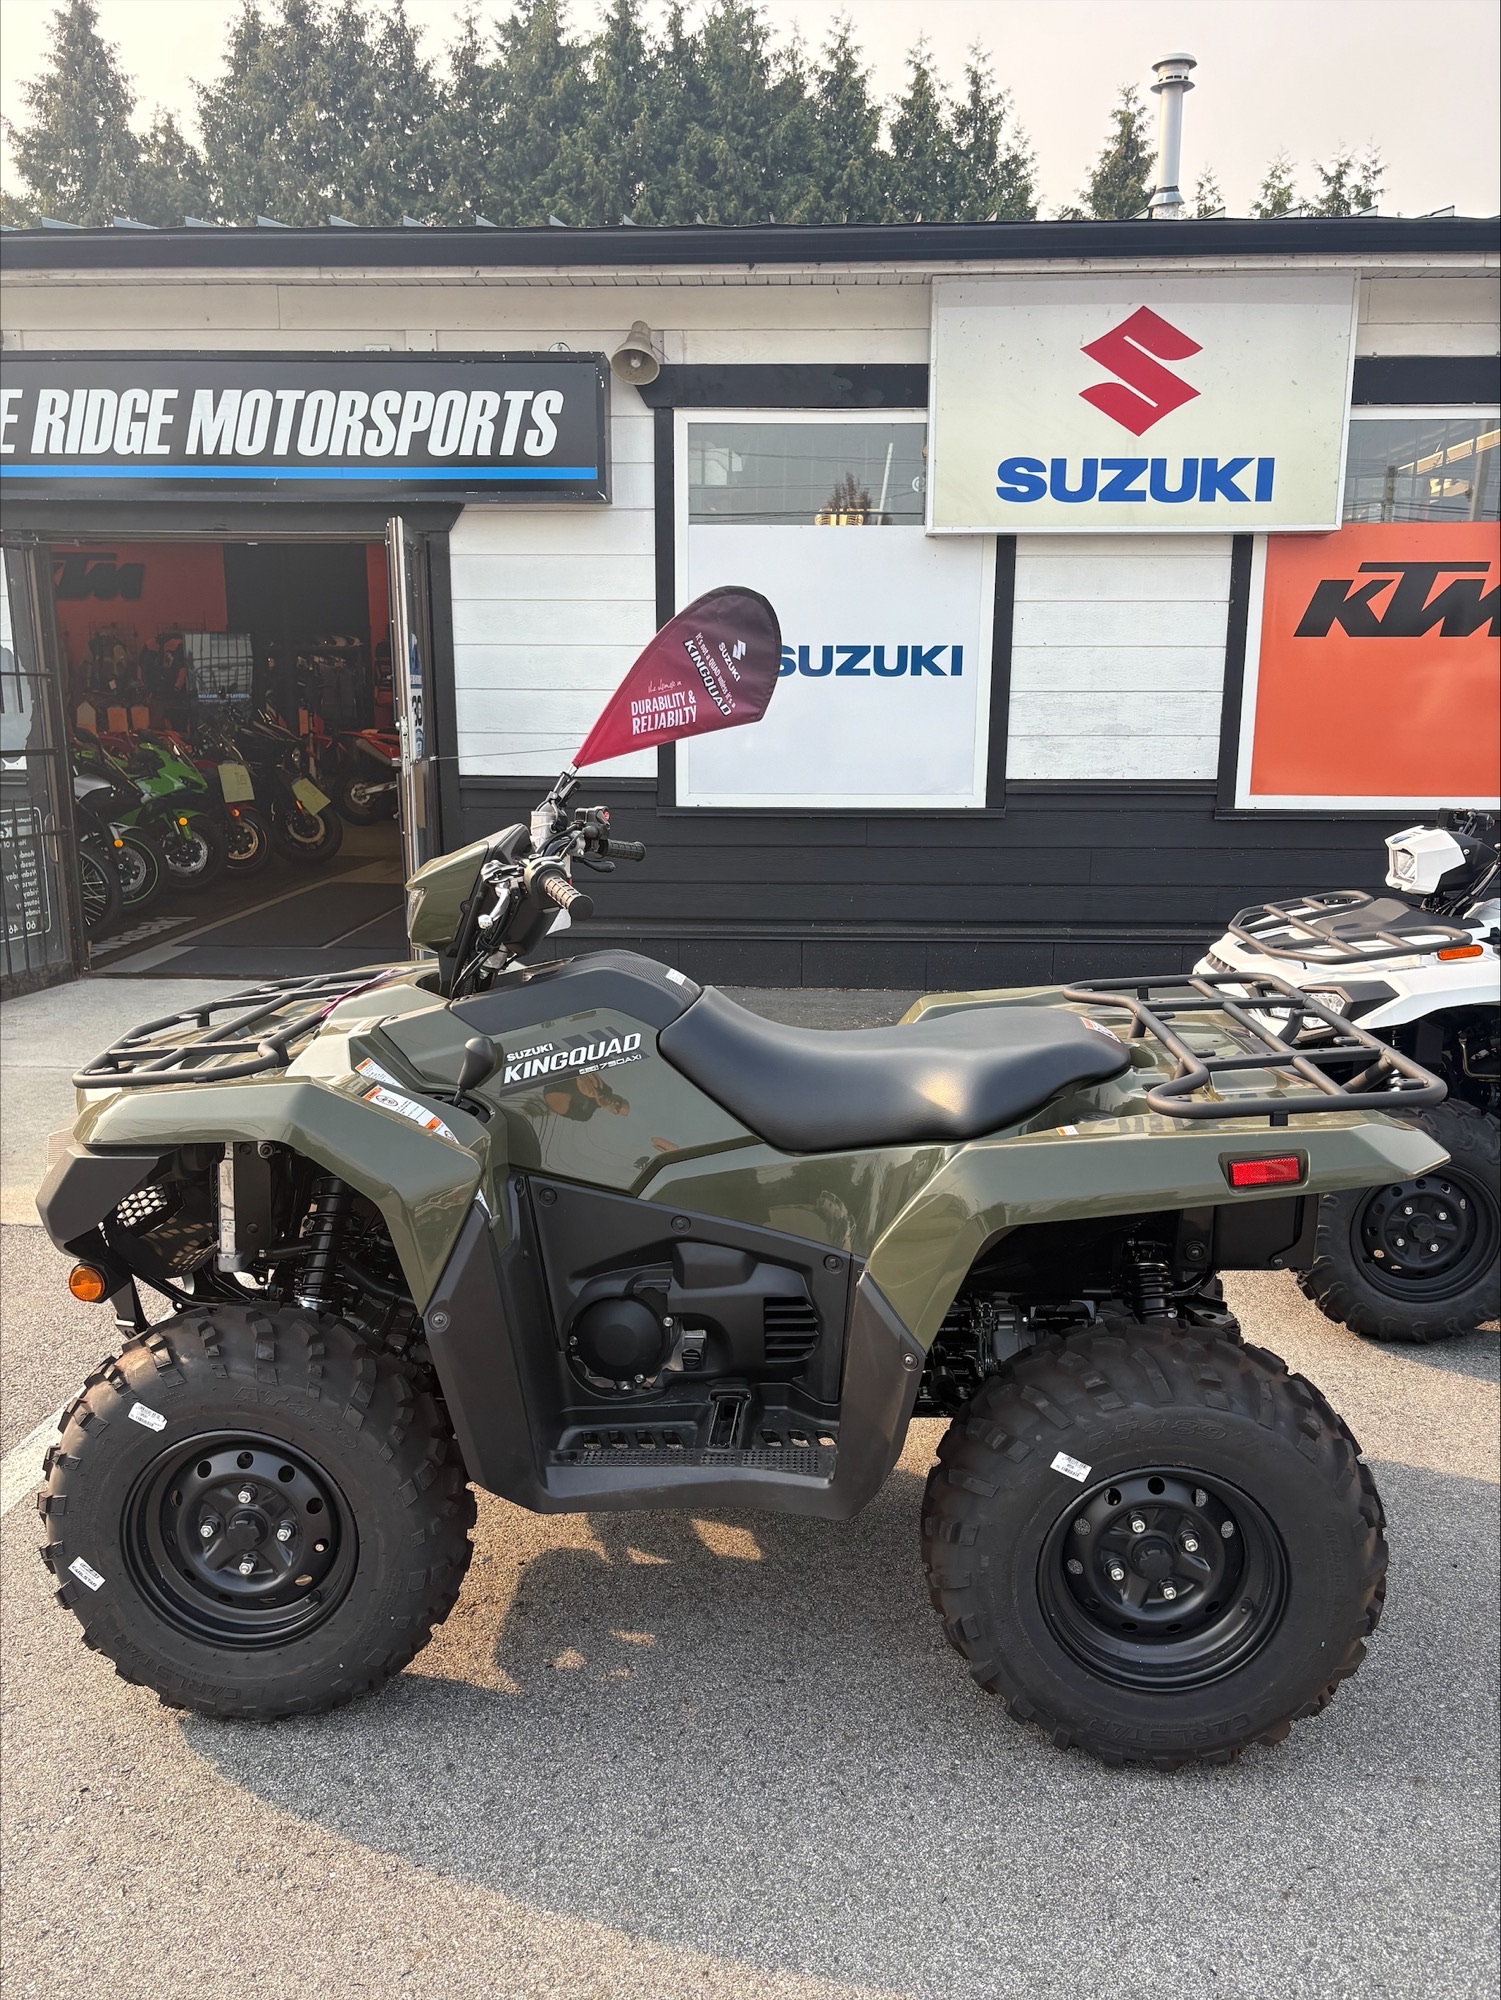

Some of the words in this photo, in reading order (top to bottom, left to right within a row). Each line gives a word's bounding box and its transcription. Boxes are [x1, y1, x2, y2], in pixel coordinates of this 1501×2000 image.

[30, 388, 179, 455] RIDGE
[185, 388, 565, 457] MOTORSPORTS
[996, 456, 1275, 503] SUZUKI
[52, 552, 145, 600] TM
[1293, 561, 1500, 637] KTM
[684, 639, 732, 716] KINGQUAD
[700, 643, 709, 656] not
[708, 657, 721, 677] QUAD
[717, 675, 728, 695] unless
[718, 642, 741, 682] SUZUKI
[631, 691, 686, 716] DURABILITY
[688, 690, 697, 704] &
[632, 705, 697, 735] RELIABILTY
[504, 1033, 642, 1084] KINGQUAD
[507, 1043, 554, 1062] SUZUKI
[1088, 1711, 1251, 1748] CARLSTAR
